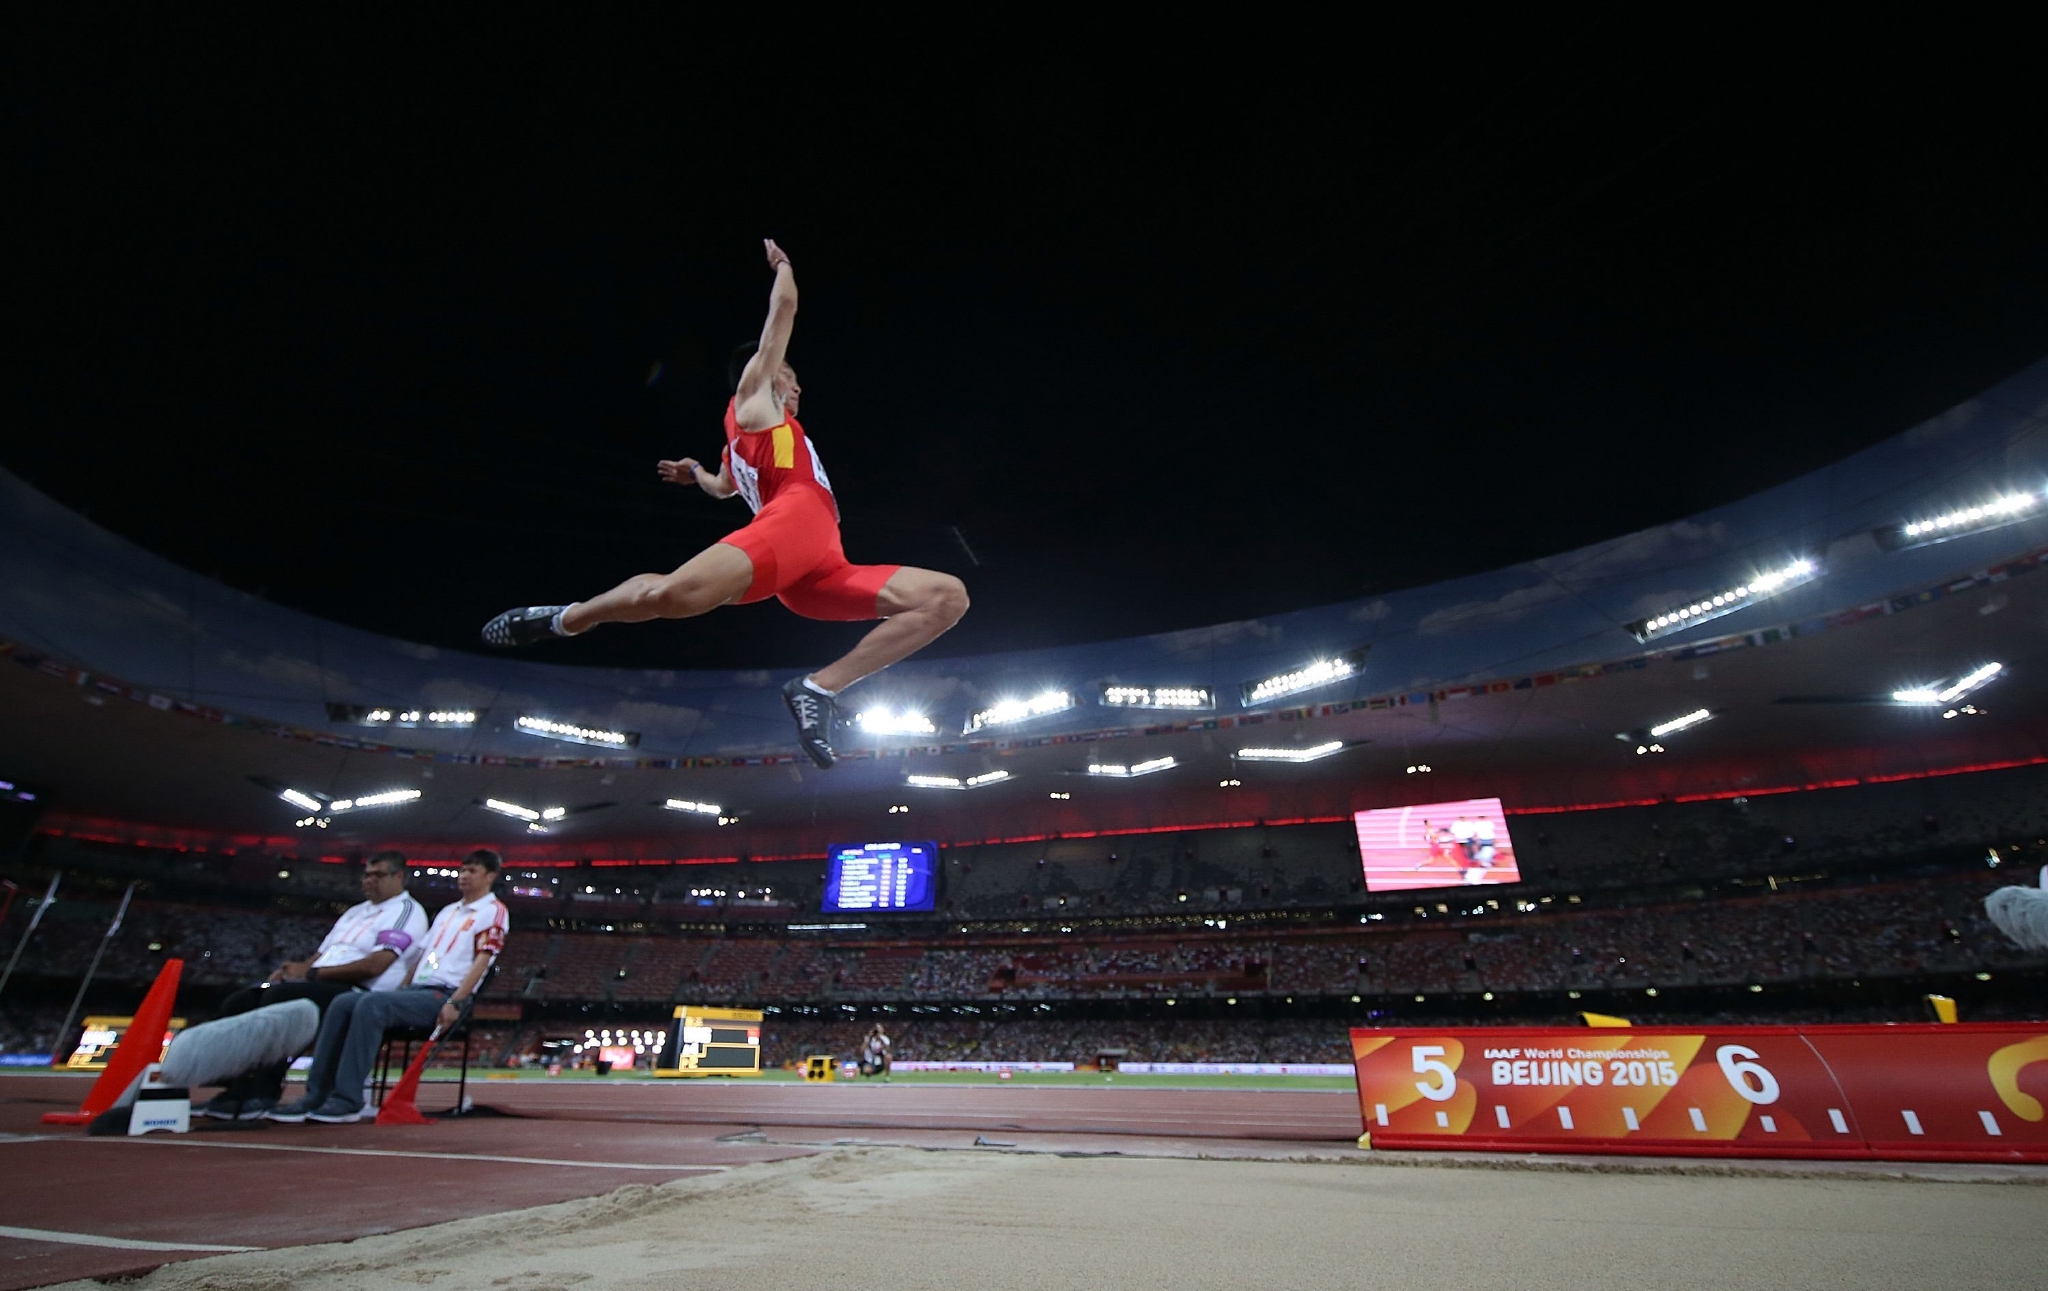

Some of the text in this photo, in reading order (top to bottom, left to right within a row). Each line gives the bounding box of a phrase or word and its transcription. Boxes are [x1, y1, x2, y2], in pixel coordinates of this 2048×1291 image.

[1412, 1046, 1457, 1101] 5
[1484, 1047, 1670, 1061] IAAF World Championships
[1492, 1061, 1678, 1085] BEIJING 2015
[1716, 1044, 1780, 1104] 6
